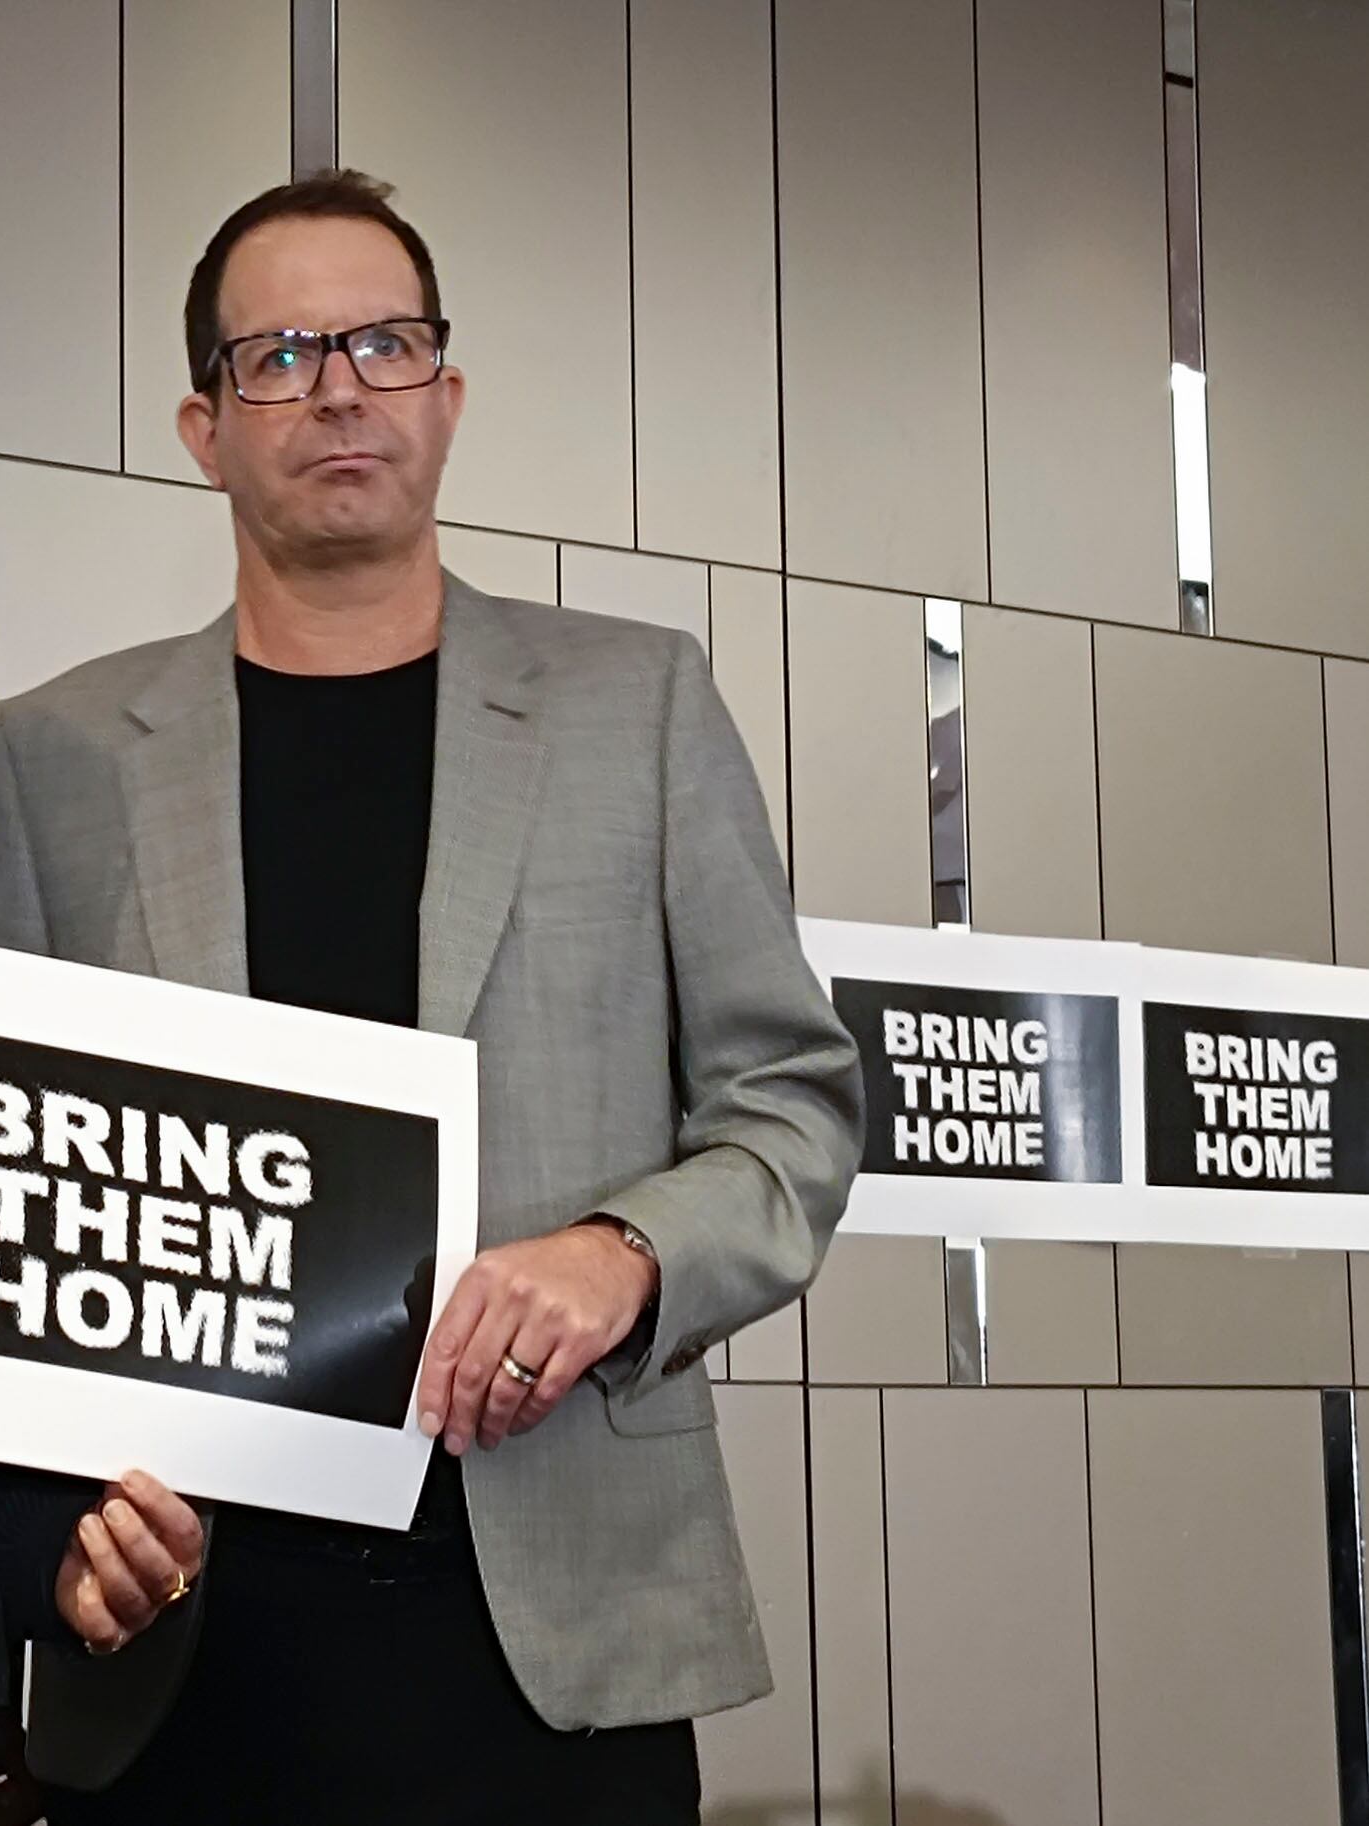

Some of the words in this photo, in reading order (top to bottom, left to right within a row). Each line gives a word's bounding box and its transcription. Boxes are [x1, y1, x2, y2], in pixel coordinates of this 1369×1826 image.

[883, 1008, 1048, 1065] BRING
[1185, 1031, 1338, 1082] BRING
[892, 1061, 1041, 1115] THEM
[1193, 1081, 1330, 1131] THEM
[893, 1113, 1044, 1166] HOME
[1194, 1130, 1333, 1180] HOME
